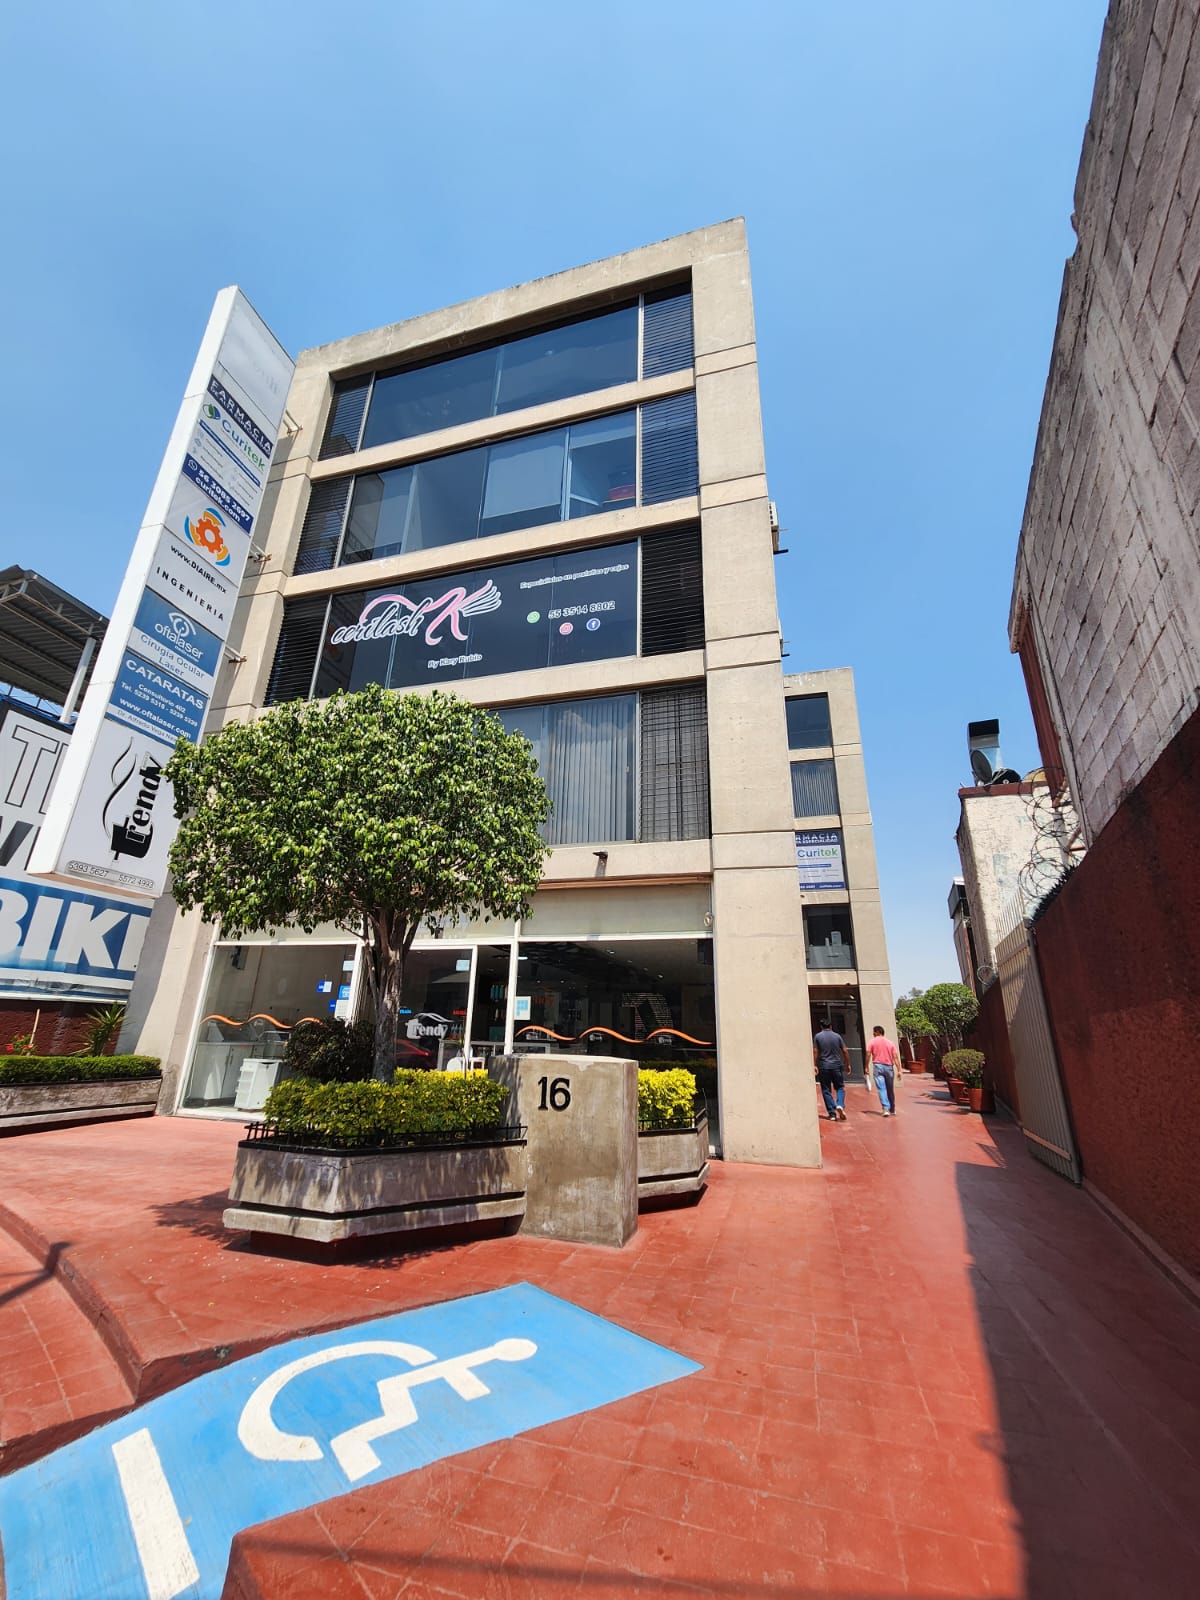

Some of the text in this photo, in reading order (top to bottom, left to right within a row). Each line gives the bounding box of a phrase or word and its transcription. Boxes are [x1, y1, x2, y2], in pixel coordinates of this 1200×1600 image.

[211, 378, 271, 452] FARMACIA
[222, 420, 265, 470] Curitek
[170, 545, 227, 594] www.DIAIRE.mx
[156, 566, 224, 621] INGENIERIA
[562, 604, 588, 617] 3514
[154, 619, 204, 659] oftalaser
[126, 659, 204, 710] CATARATAS
[176, 657, 205, 679] Ocular
[119, 698, 192, 740] www.oftalaser.com
[797, 848, 838, 857] Curitek
[537, 1076, 571, 1113] 16
